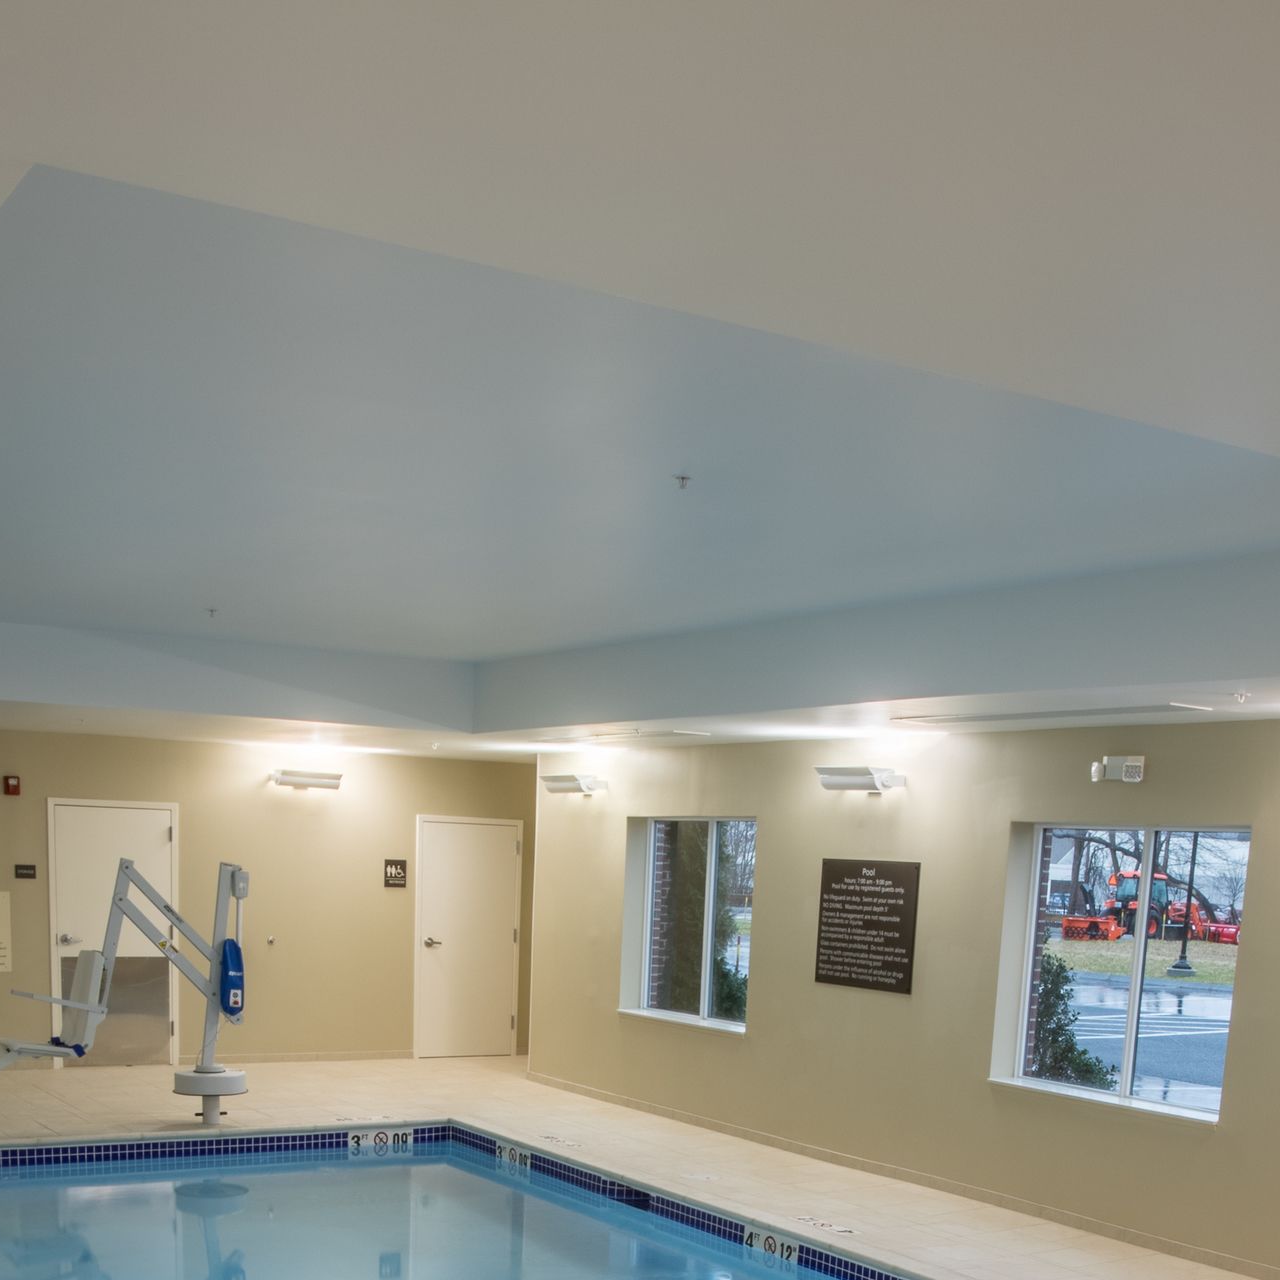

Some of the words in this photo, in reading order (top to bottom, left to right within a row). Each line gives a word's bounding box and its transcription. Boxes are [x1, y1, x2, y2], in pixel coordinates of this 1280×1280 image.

[862, 868, 875, 876] Pool
[351, 1134, 360, 1146] 3
[745, 1232, 753, 1247] 4
